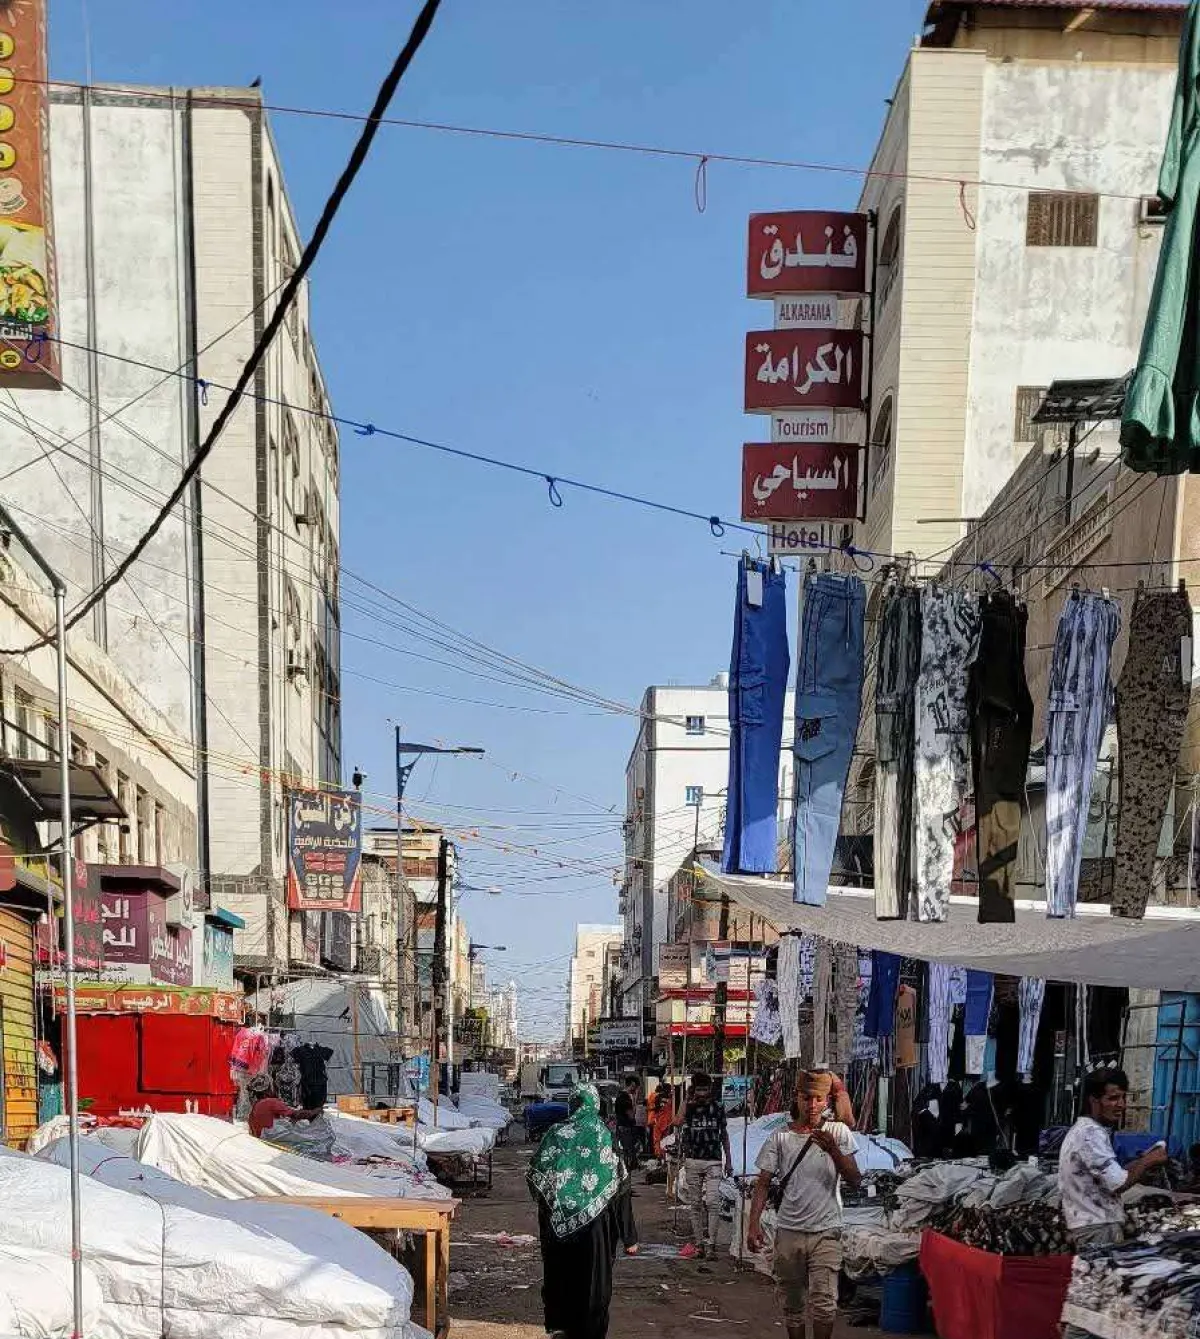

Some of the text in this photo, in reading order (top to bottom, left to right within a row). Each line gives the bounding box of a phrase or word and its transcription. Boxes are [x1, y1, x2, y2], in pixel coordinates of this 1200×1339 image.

[759, 224, 857, 280] فندق
[778, 303, 832, 321] ALKARAMA
[755, 341, 853, 395] الكرامة
[777, 418, 829, 437] Tourism
[752, 453, 850, 506] السياحي
[772, 523, 825, 549] Hotel
